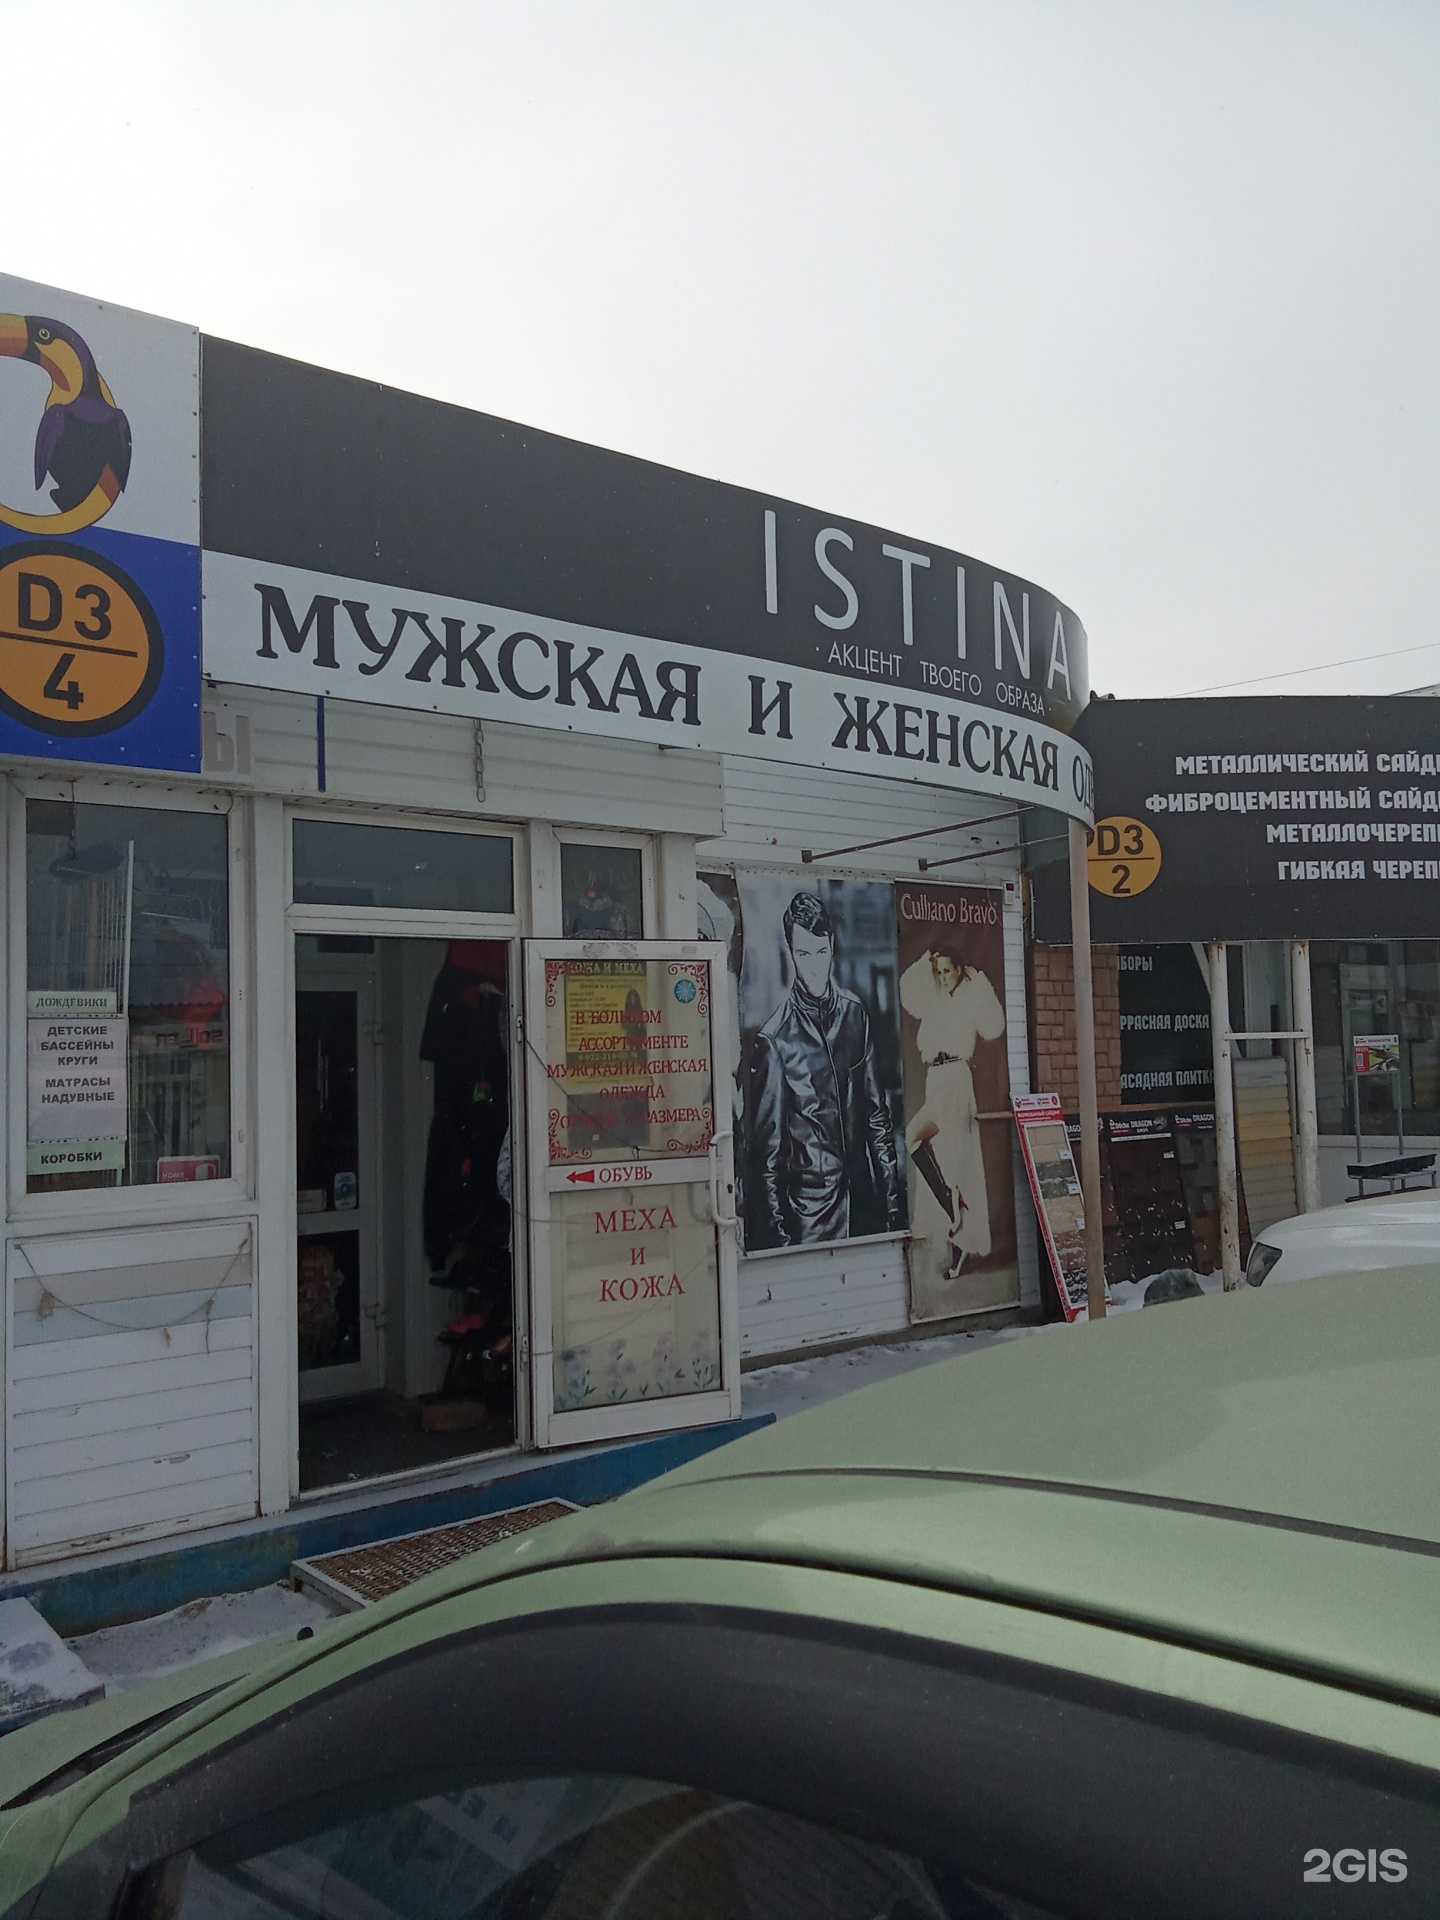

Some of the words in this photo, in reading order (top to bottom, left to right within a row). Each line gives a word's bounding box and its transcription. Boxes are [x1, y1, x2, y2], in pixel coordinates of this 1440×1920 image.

[18, 572, 113, 641] D3
[764, 510, 1072, 700] ISTINA
[43, 654, 85, 710] 4
[254, 583, 702, 726] МУЖСКАЯ
[748, 675, 793, 739] И
[831, 692, 1060, 792] ЖЕНСКАЯ
[827, 641, 903, 678] АКЦЕНТ
[920, 660, 982, 696] ТВОЕГО
[995, 682, 1046, 716] ОБРАЗА
[1175, 750, 1369, 776] МЕТАЛЛИЧЕСКИЙ
[1145, 786, 1371, 813] ФИБРОЦЕМЕНТНЫЙ
[1378, 786, 1440, 812] САЙД
[1097, 824, 1144, 856] D3
[1111, 864, 1131, 894] 2
[1278, 860, 1366, 880] ГИБКАЯ
[1373, 859, 1440, 880] ЧЕРЕП
[900, 893, 957, 923] Culliano
[1117, 955, 1153, 972] БОРЫ
[47, 1026, 108, 1038] ДЕТСКИЕ
[1174, 1013, 1210, 1031] ДОСКА
[40, 1039, 114, 1051] БАССЕЙНЫ
[57, 1055, 98, 1066] КРУГИ
[638, 1058, 708, 1076] ЖЕНСКАЯ
[45, 1076, 111, 1088] МАТРАСЫ
[1175, 1069, 1215, 1087] ПЛИТК
[41, 1091, 116, 1105] НАДУВНЫЕ
[40, 1152, 103, 1164] КОРОБКИ
[599, 1166, 653, 1184] ОБУВЬ
[594, 1207, 679, 1234] МЕХА
[630, 1247, 646, 1266] И
[600, 1272, 686, 1302] КОЖА
